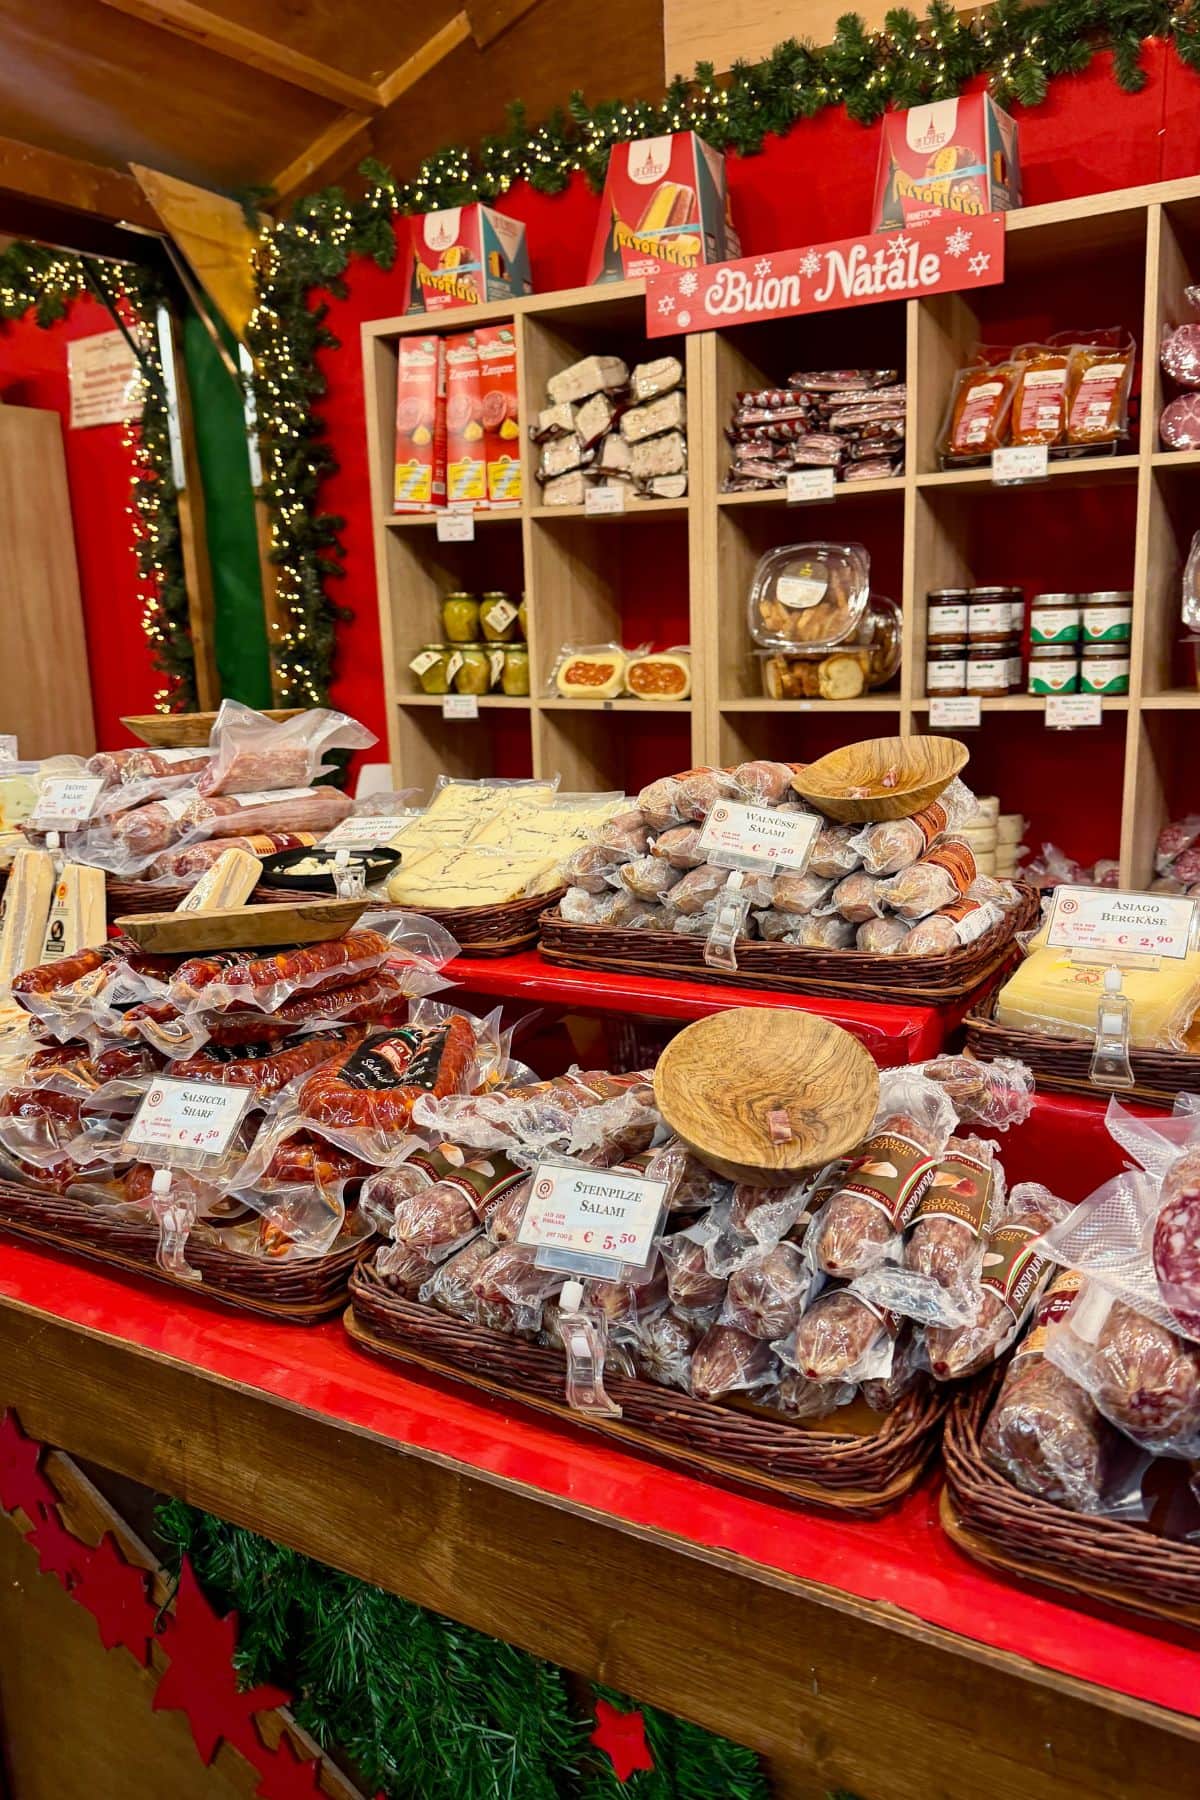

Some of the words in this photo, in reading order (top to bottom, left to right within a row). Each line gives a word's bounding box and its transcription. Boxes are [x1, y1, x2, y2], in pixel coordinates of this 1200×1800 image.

[705, 268, 800, 316] Buon
[814, 241, 941, 302] Natale
[746, 811, 799, 830] WALNÜSSE
[748, 824, 786, 839] SALAMI
[752, 843, 761, 852] €
[1112, 901, 1160, 913] ASIAGO
[1101, 912, 1168, 926] BERGKÄSE
[1118, 935, 1128, 945] €
[181, 1091, 228, 1106] SALSICCIA
[181, 1105, 215, 1119] SHARF
[179, 1128, 188, 1140] €
[573, 1181, 644, 1203] STEINPILZE
[579, 1199, 627, 1218] SALAMI
[583, 1231, 594, 1243] €
